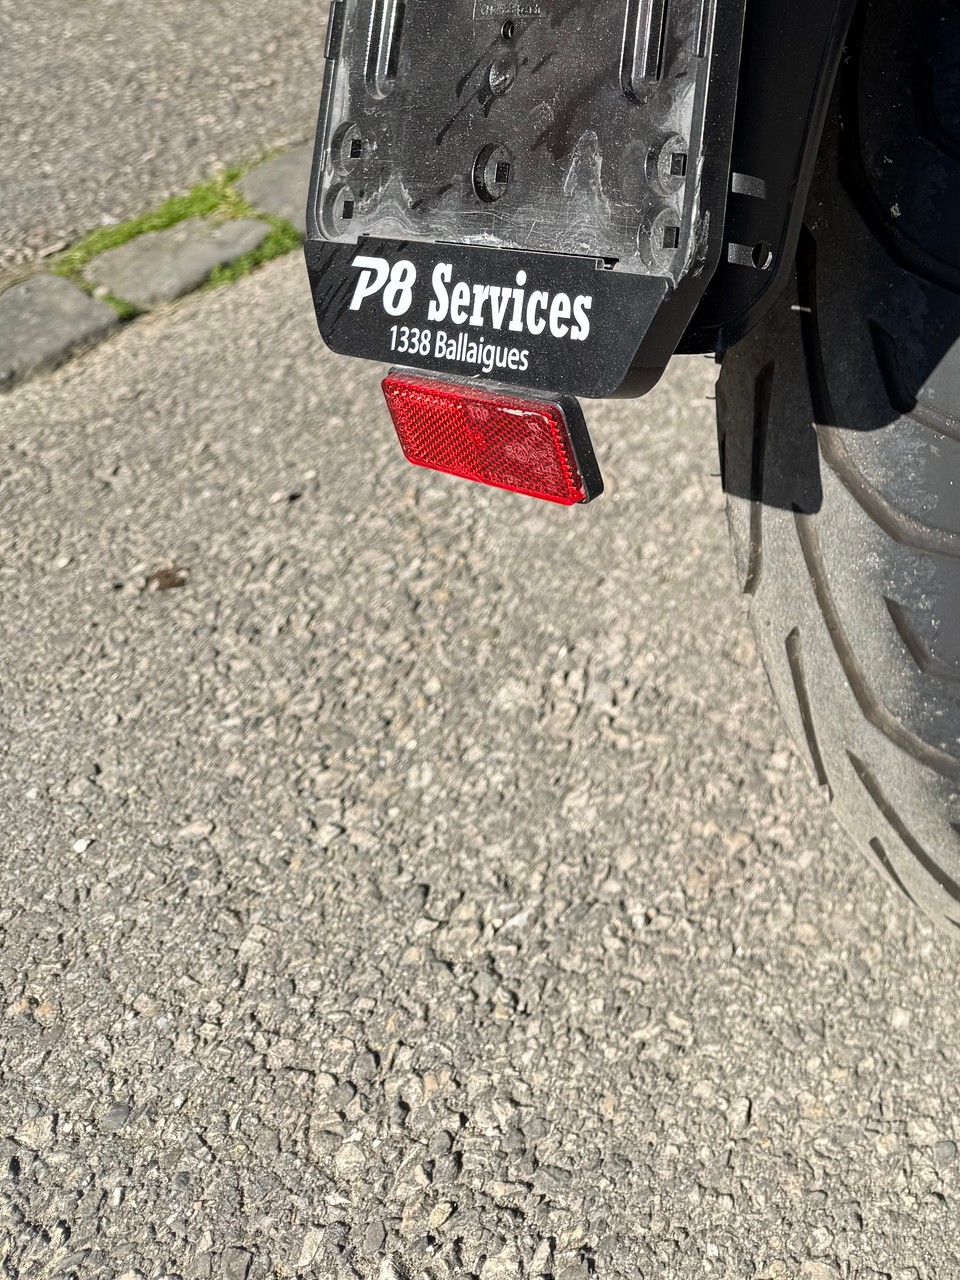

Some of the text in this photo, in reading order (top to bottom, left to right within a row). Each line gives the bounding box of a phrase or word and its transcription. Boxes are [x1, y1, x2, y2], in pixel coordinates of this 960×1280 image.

[349, 255, 593, 341] P8 Services
[389, 324, 530, 373] 1338 Ballaigues
